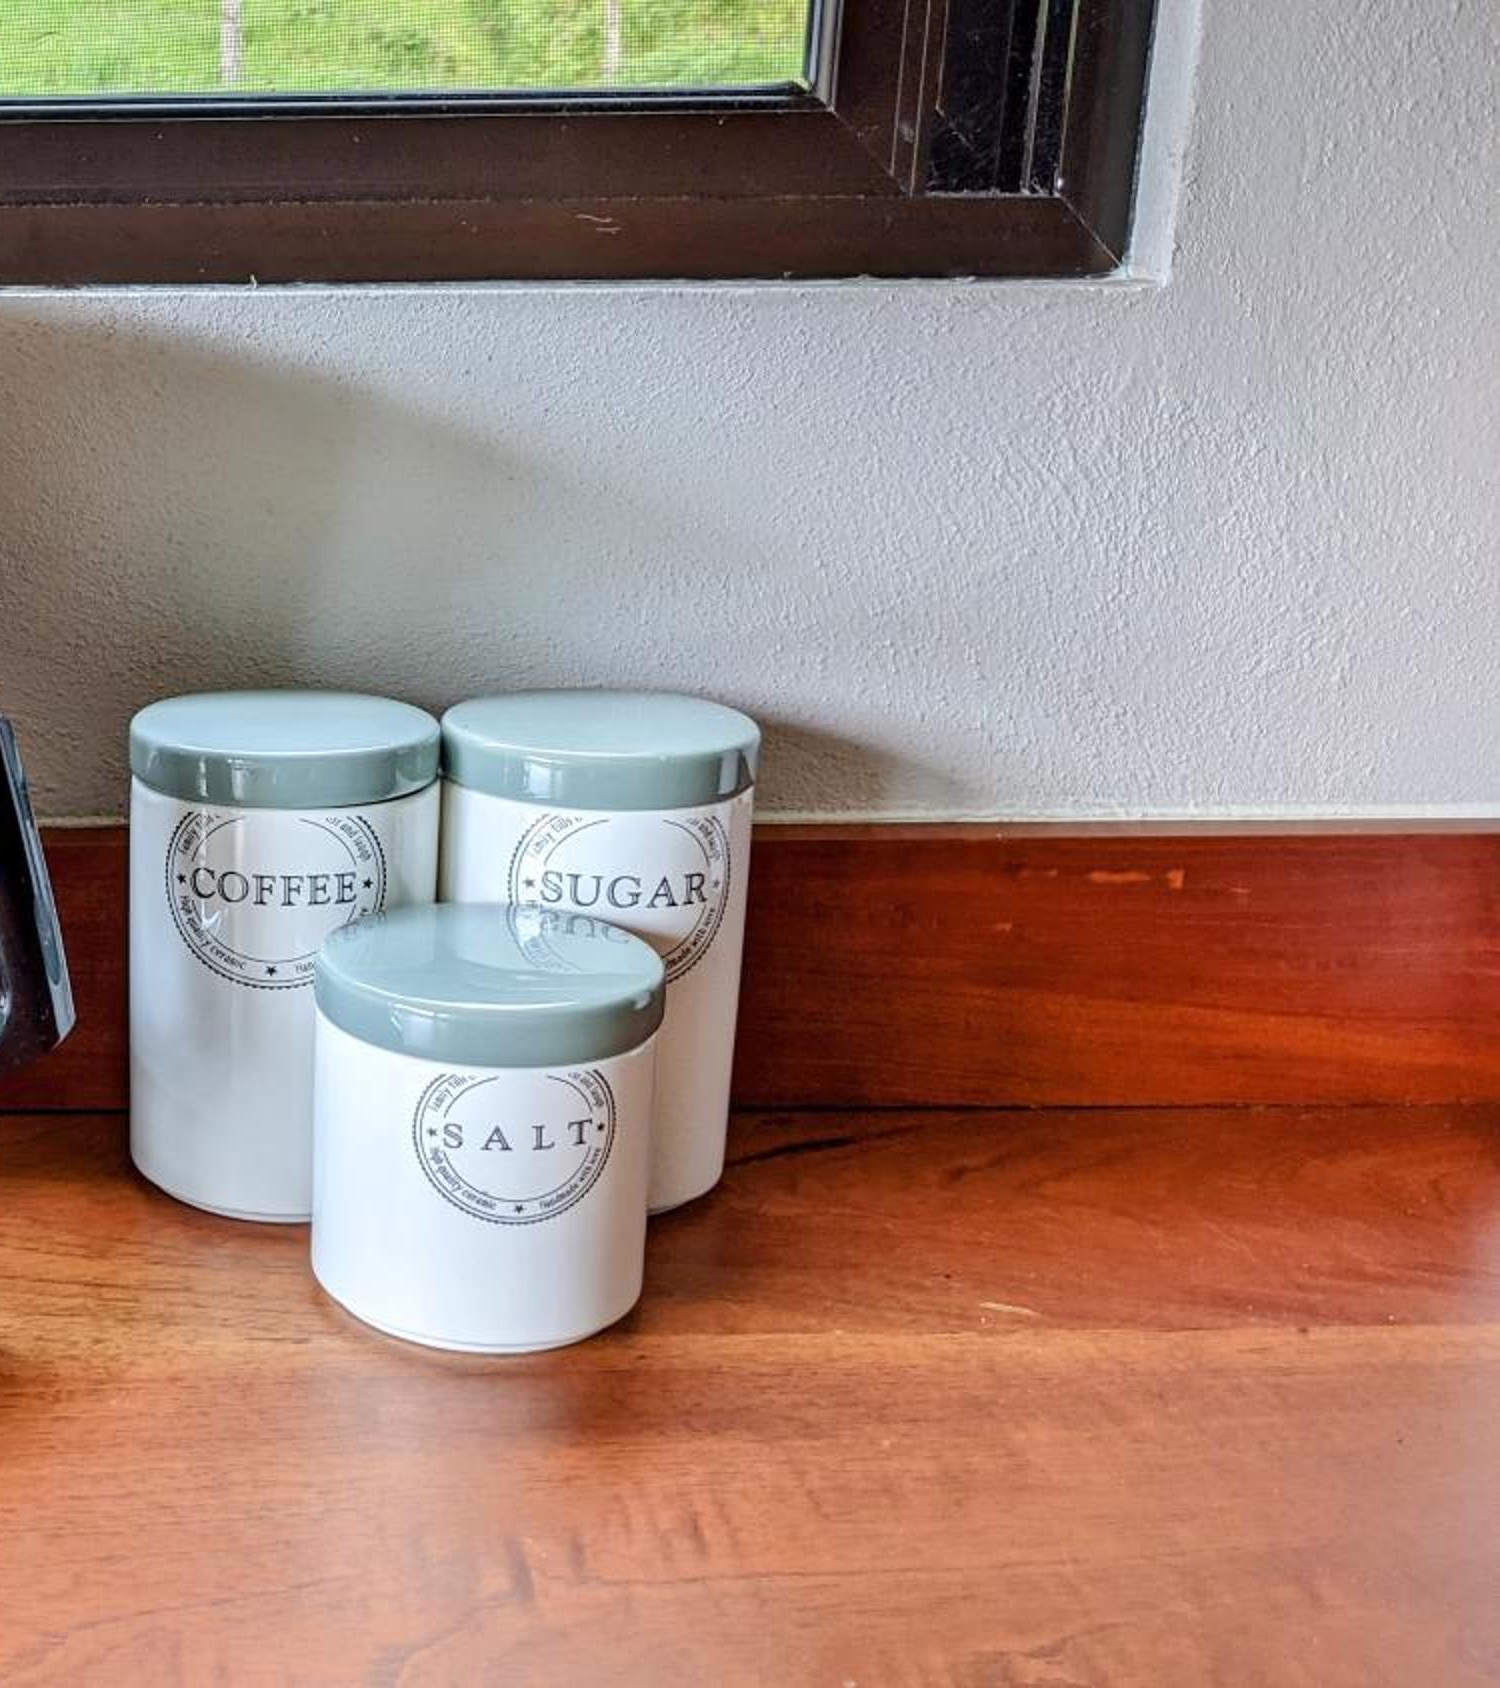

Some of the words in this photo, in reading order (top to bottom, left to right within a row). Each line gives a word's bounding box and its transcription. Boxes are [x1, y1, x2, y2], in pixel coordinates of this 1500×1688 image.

[190, 866, 357, 907] COFFEE
[540, 870, 708, 909] SUGAR
[442, 1117, 594, 1152] SALT
